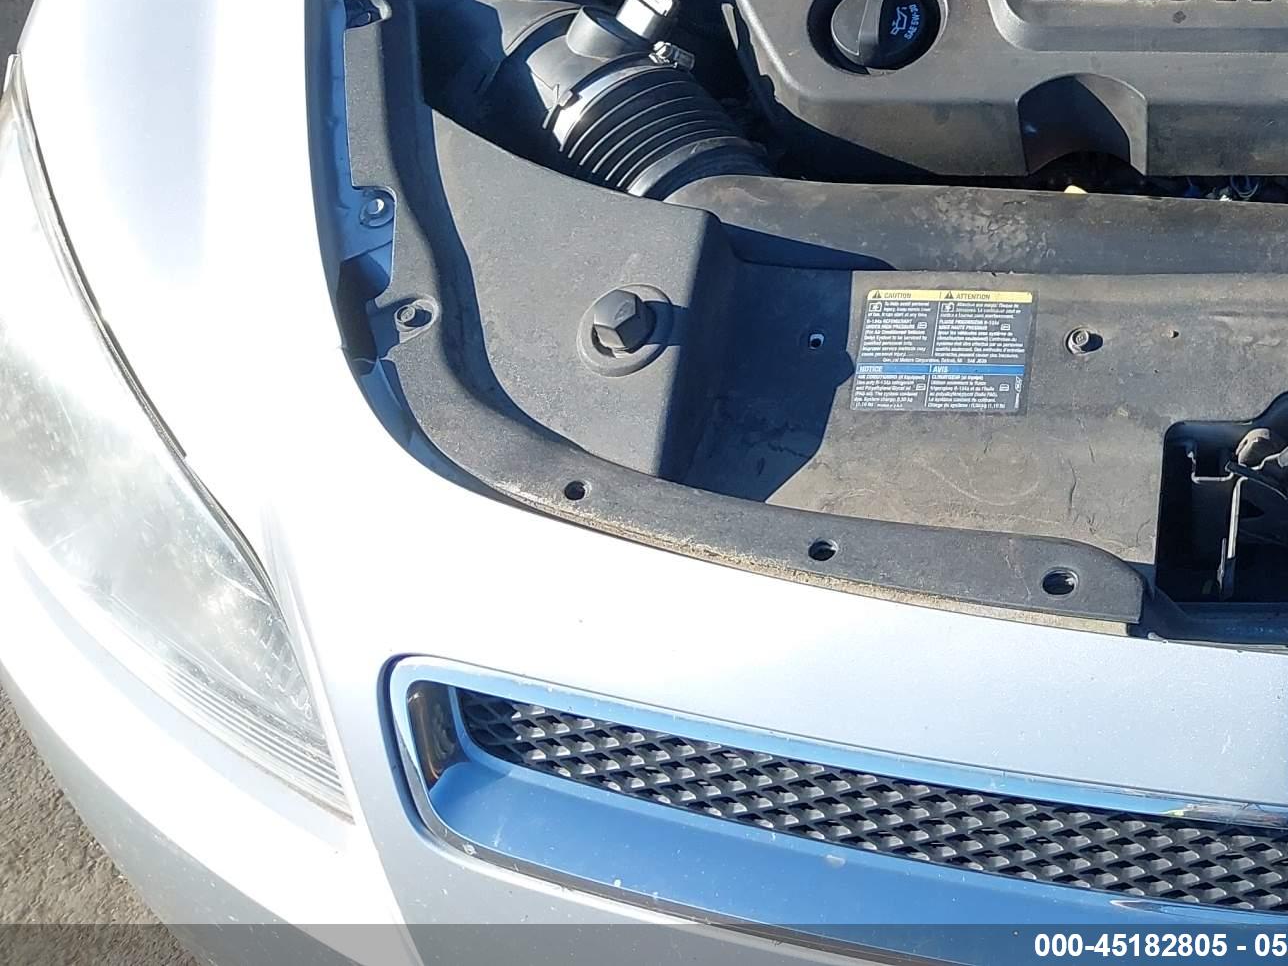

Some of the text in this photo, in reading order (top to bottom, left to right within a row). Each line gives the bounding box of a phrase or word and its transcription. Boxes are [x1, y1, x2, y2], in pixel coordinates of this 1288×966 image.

[903, 25, 918, 40] SAE
[859, 365, 883, 373] NOTICE
[932, 365, 949, 373] AVIS
